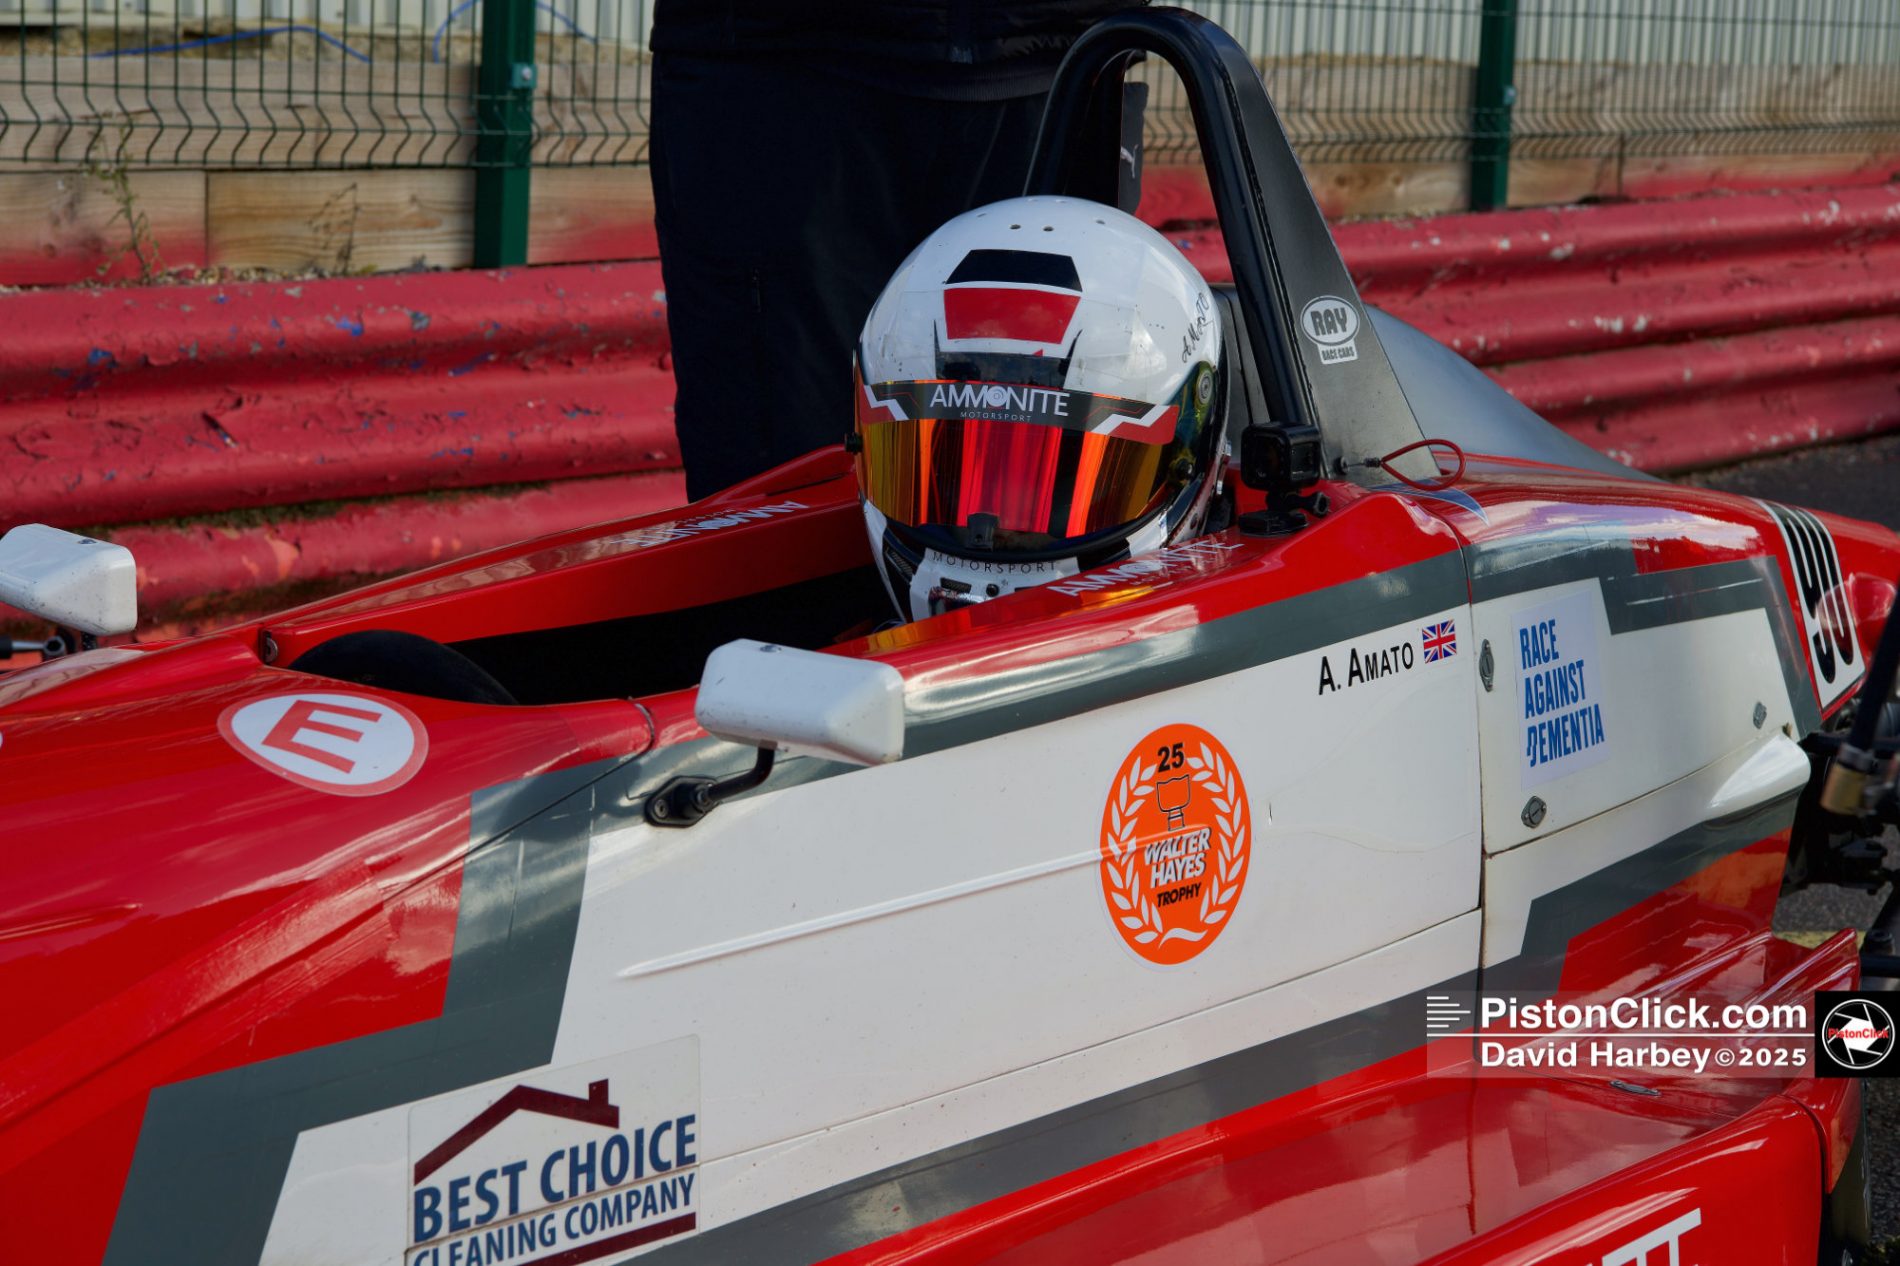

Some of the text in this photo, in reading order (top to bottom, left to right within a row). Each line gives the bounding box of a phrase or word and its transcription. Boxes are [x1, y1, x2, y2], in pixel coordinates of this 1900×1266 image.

[1310, 307, 1348, 336] RAY
[1321, 346, 1355, 361] RACE CARS
[929, 384, 1071, 417] AMMONITE
[960, 411, 1032, 422] MOTORSPORT
[932, 551, 1057, 574] MOTORSPORT
[1519, 618, 1560, 670] RACE
[1318, 655, 1342, 696] A.
[1524, 659, 1587, 720] AGAINST
[261, 700, 382, 774] E
[1526, 703, 1606, 768] DEMENTIA
[1157, 742, 1185, 773] 25
[1143, 826, 1213, 866] WALTER
[1151, 851, 1207, 889] HAYES
[1157, 882, 1202, 908] TROPHY
[414, 1113, 697, 1243] BEST CHOICE
[564, 1172, 696, 1240] COMPANY
